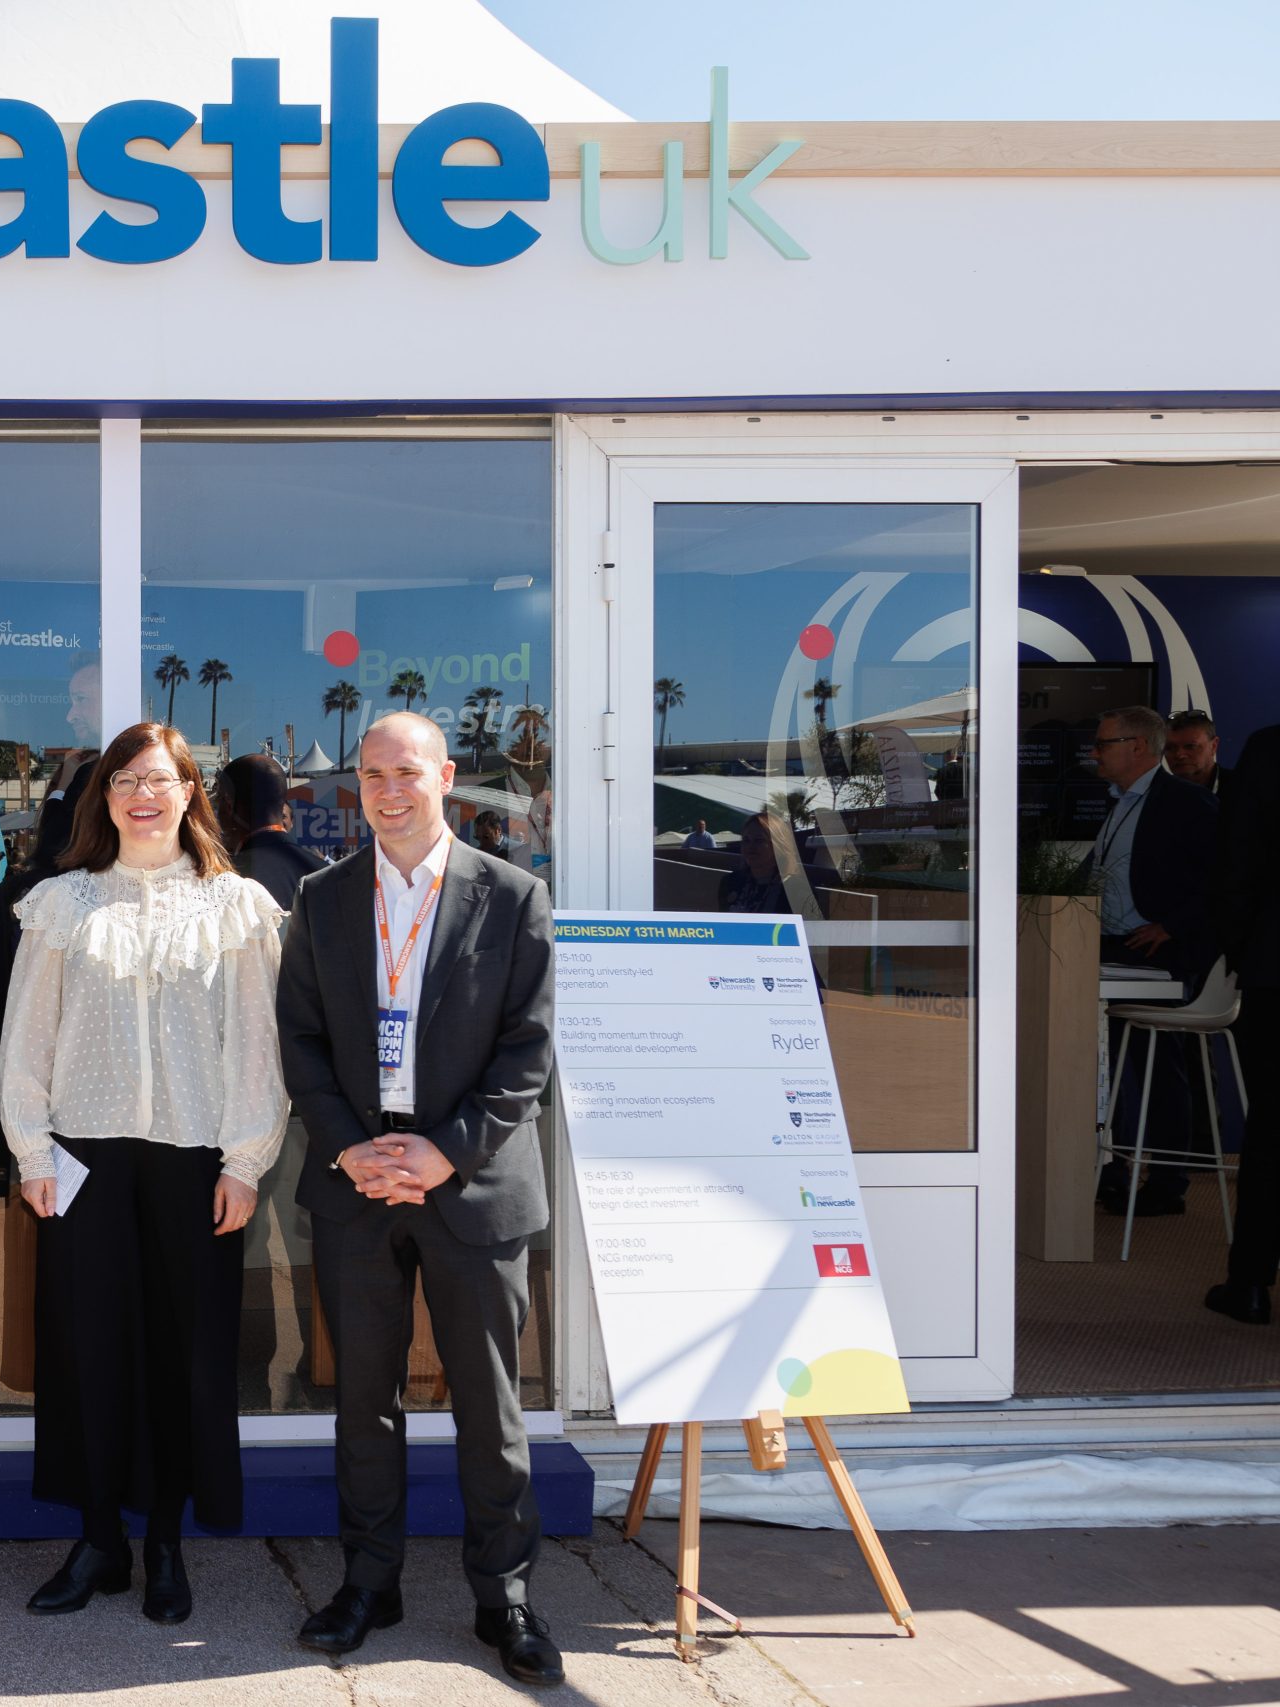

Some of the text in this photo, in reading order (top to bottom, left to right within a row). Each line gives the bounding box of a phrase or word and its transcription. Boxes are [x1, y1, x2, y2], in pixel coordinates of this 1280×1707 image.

[580, 66, 811, 266] uk
[64, 633, 82, 649] uk
[358, 642, 531, 696] Beyond
[415, 888, 437, 925] MANCHESTER
[554, 925, 715, 939] WEDNESDAY 13TH MARCH
[395, 938, 415, 977] MANCHESTER
[756, 955, 803, 964] Sponsored by
[596, 967, 654, 977] university-led
[556, 980, 609, 991] egeneration
[719, 976, 755, 984] Newcastle
[720, 983, 756, 992] University
[558, 1016, 602, 1026] 11:30-12:15
[769, 1017, 816, 1027] Sponsored by
[561, 1030, 683, 1041] Building momentum through
[563, 1044, 697, 1054] transformational developments
[772, 1033, 820, 1055] Ryder
[378, 1049, 401, 1063] 024
[569, 1082, 616, 1092] 14:30-15:15
[782, 1077, 829, 1086] Sponsored by
[796, 1090, 832, 1098] Newcastle
[572, 1095, 715, 1107] Fostering innovation ecosystems
[797, 1097, 832, 1105] University
[573, 1109, 664, 1119] to attract investment
[584, 1171, 634, 1182] 15:45-16:30
[800, 1169, 849, 1178] Sponsored by
[586, 1184, 745, 1197] The role of government in attracting
[588, 1199, 700, 1211] foreign direct investment
[817, 1198, 856, 1207] newcastle
[812, 1230, 862, 1239] Sponsored by
[595, 1237, 647, 1249] 17:00-18:00
[597, 1252, 674, 1264] NCG networking
[600, 1267, 645, 1279] reception
[834, 1265, 854, 1274] NCG
